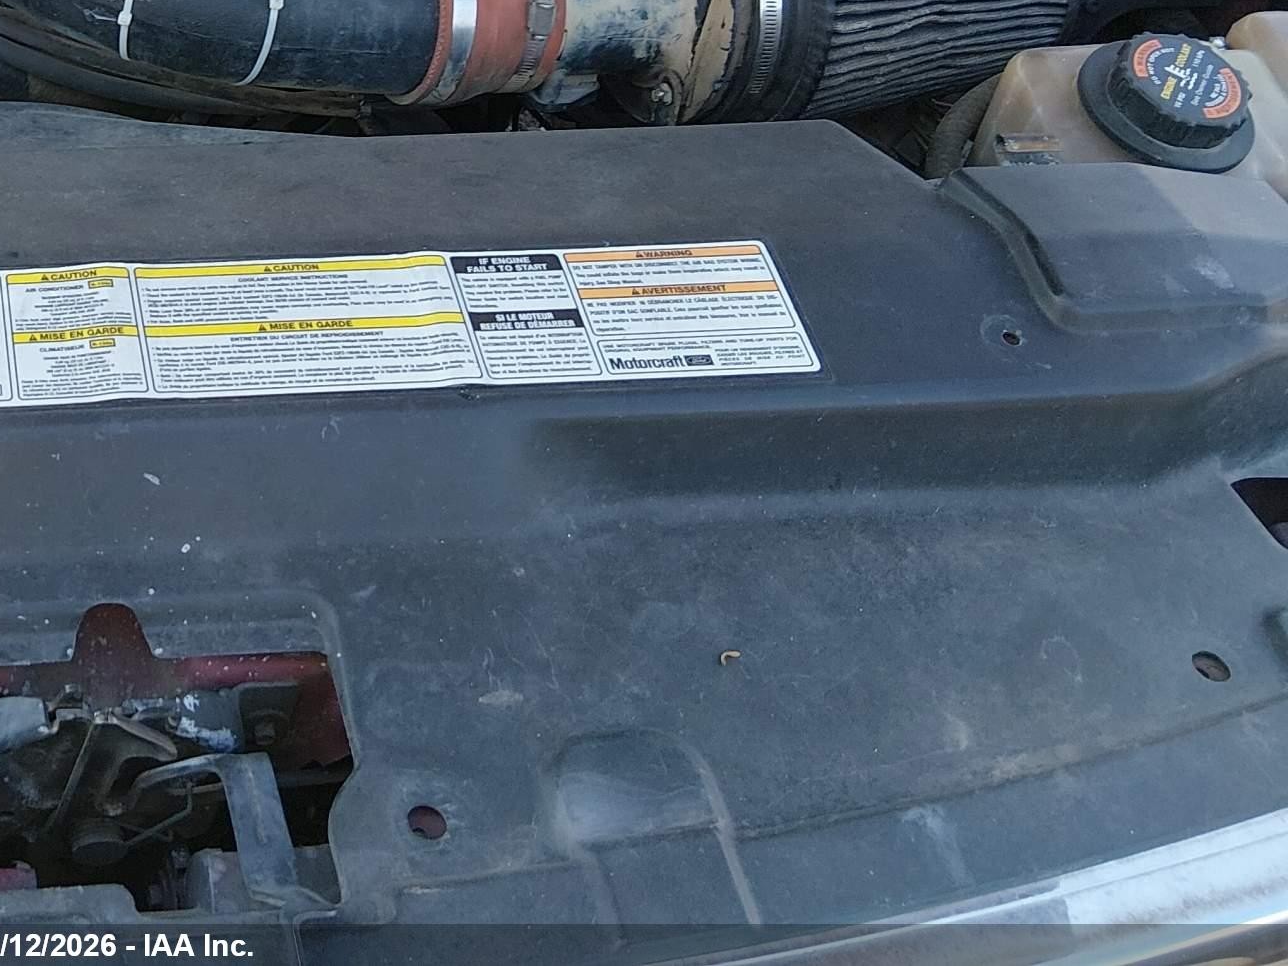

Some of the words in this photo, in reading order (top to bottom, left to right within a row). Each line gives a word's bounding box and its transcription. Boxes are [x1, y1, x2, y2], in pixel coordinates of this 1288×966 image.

[467, 265, 495, 273] FAILS
[51, 270, 97, 280] CAUTION
[642, 285, 726, 294] AVERTISSEMENT
[506, 313, 517, 321] LE
[518, 312, 554, 320] MOTEUR
[269, 322, 296, 330] MISE
[299, 321, 313, 329] EN
[317, 319, 353, 328] GARDE
[480, 322, 514, 330] REFUSE
[87, 327, 124, 336] GARDE
[609, 355, 685, 370] Motorcraft
